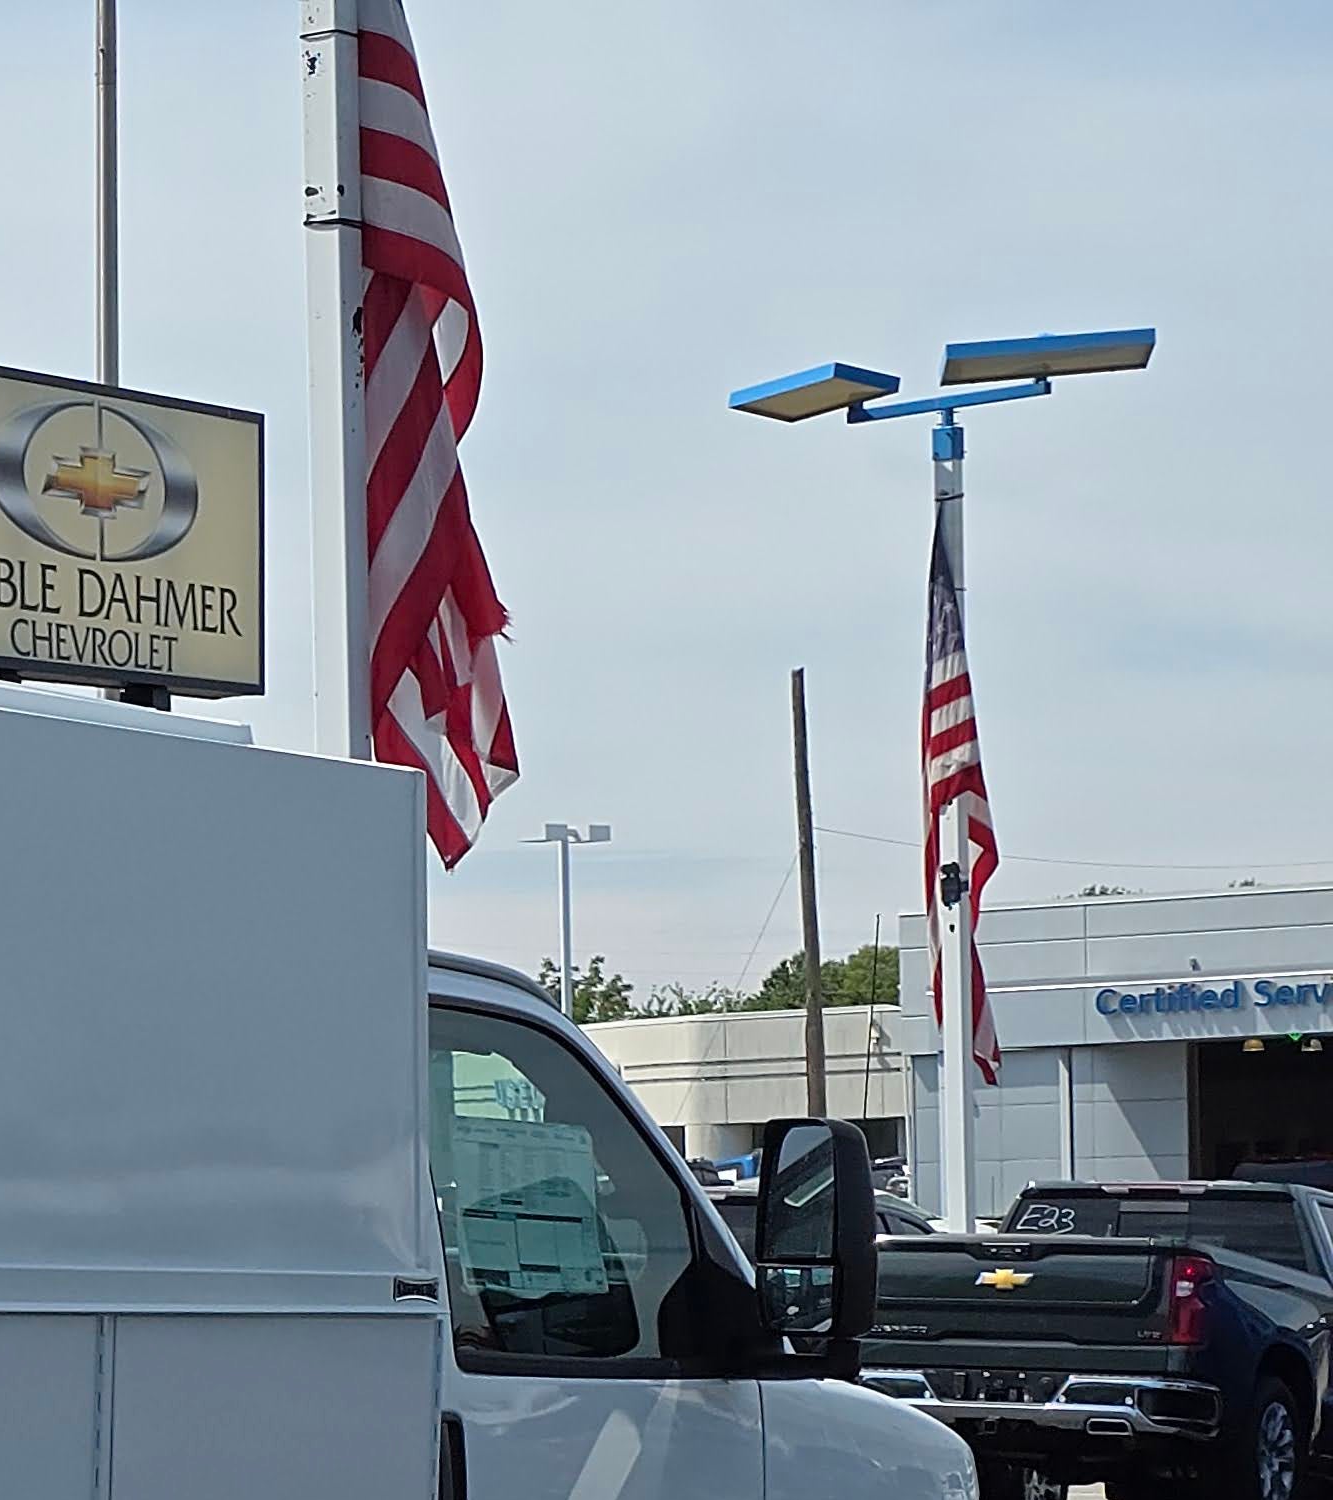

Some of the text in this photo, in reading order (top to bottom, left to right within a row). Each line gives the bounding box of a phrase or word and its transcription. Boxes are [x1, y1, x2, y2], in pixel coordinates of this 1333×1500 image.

[78, 567, 243, 637] DAHMER
[10, 618, 179, 673] CHEVROLET
[1096, 980, 1240, 1016] Certified
[1016, 1204, 1075, 1234] E23
